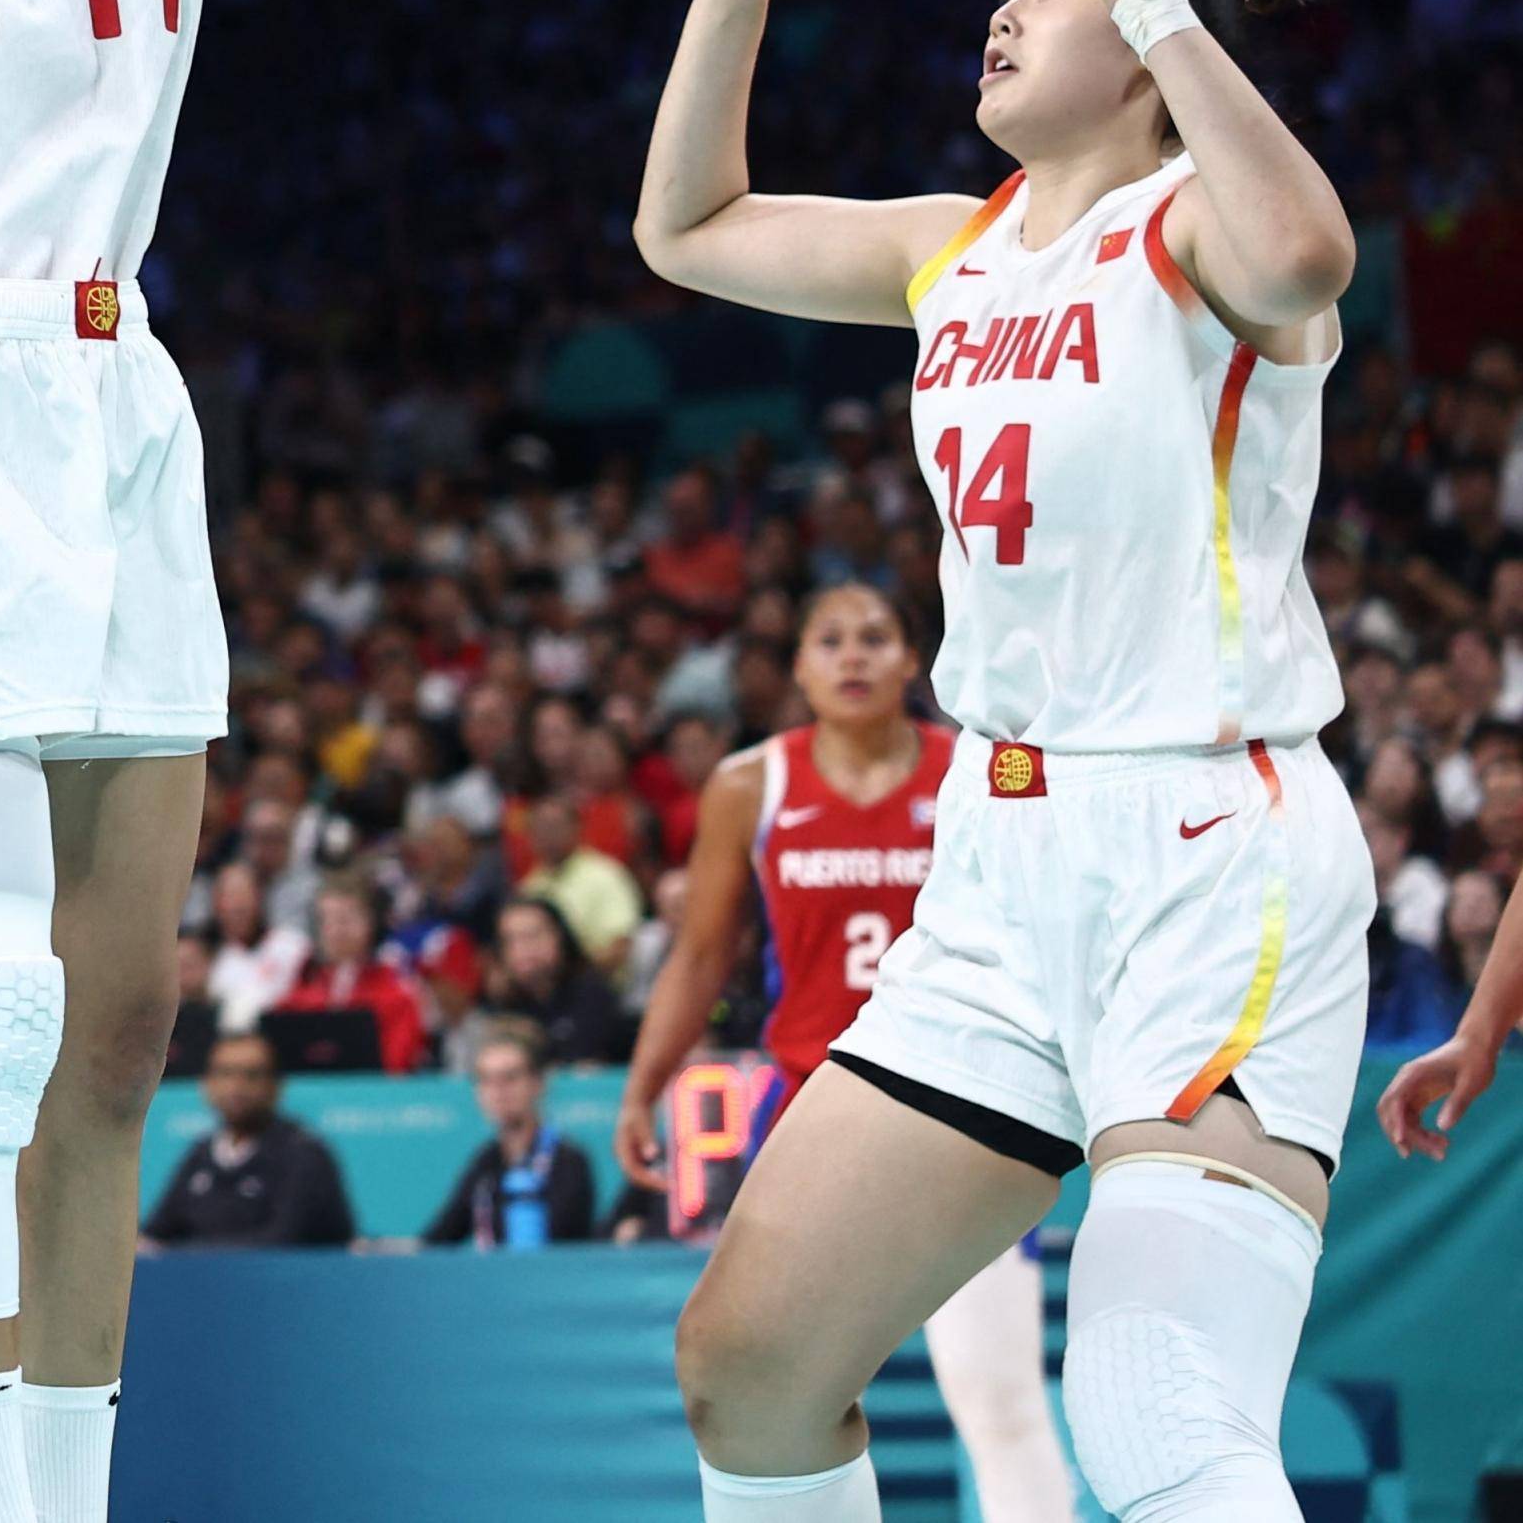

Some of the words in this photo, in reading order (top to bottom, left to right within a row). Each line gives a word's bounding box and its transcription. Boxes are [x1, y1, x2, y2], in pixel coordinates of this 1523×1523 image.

[915, 303, 1100, 392] CHINA
[934, 423, 1033, 566] 14
[779, 849, 883, 888] PUERTO
[885, 848, 933, 887] RIC
[845, 911, 891, 990] 2
